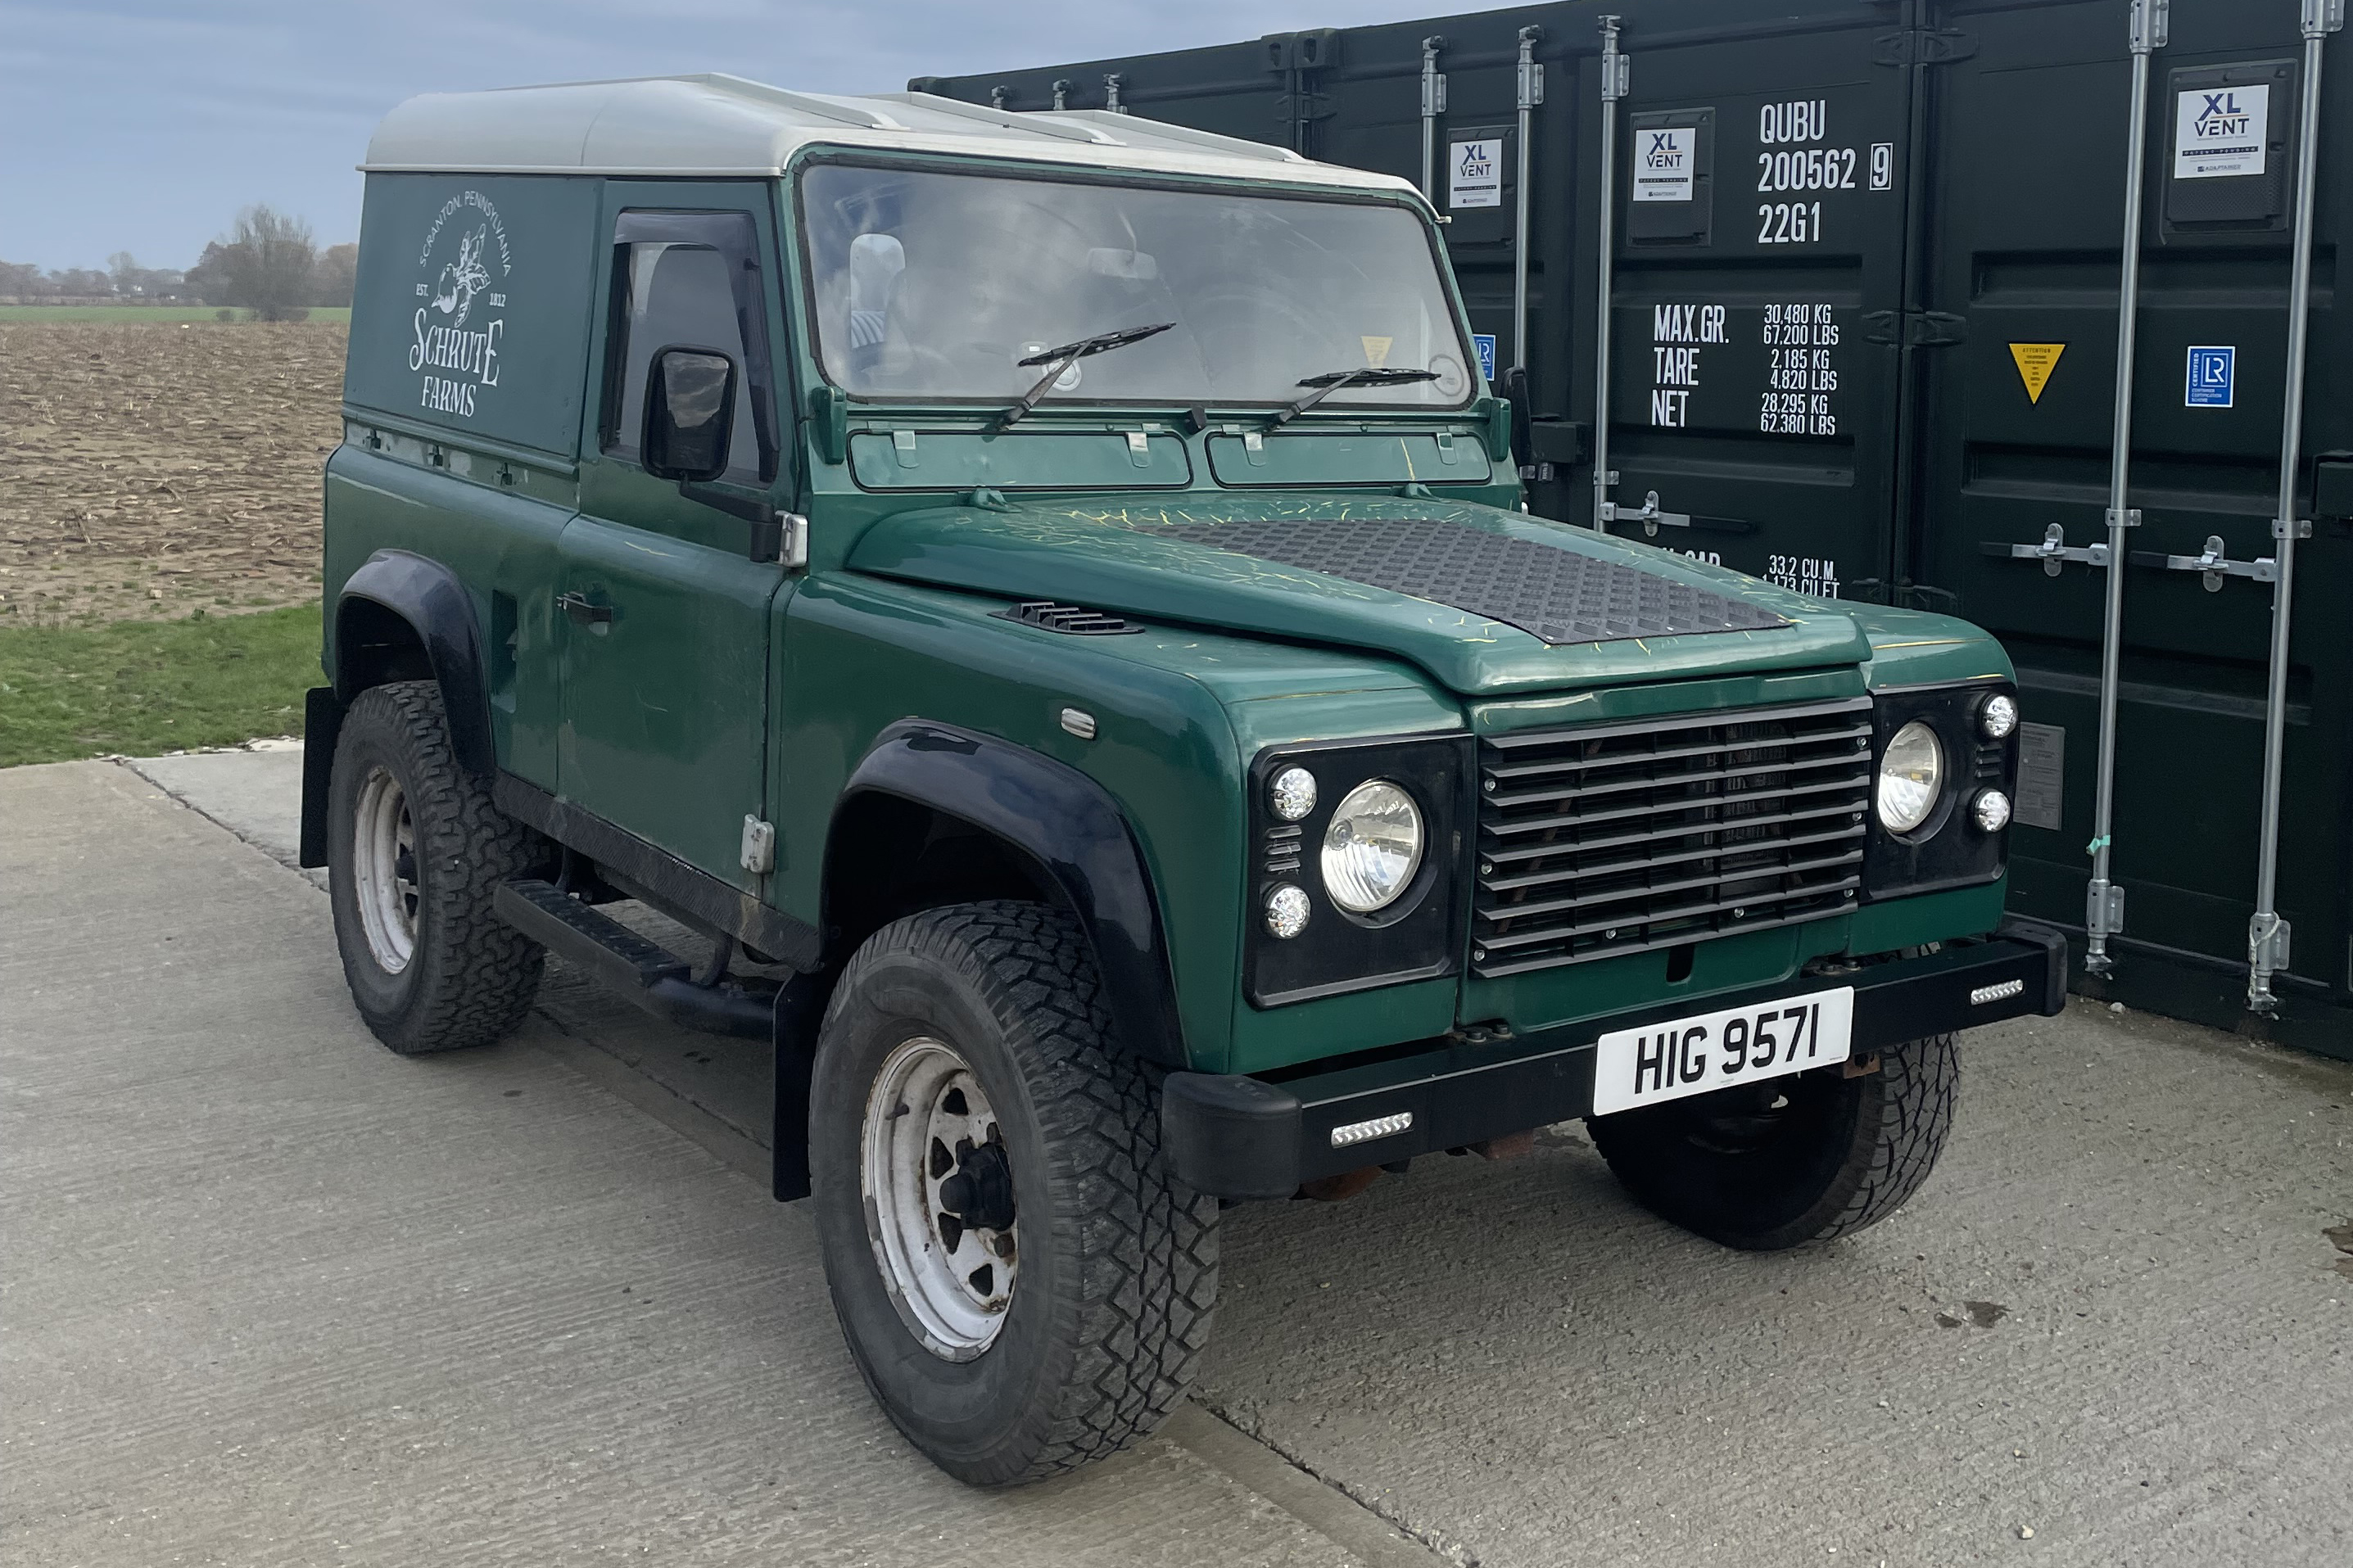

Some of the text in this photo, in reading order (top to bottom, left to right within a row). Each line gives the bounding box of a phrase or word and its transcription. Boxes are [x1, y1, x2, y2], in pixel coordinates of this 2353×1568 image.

[2197, 92, 2242, 121] XL
[1760, 99, 1826, 144] QUBU
[2194, 118, 2250, 137] VENT
[1462, 144, 1486, 166] XL
[1649, 133, 1677, 156] XL
[1460, 163, 1491, 178] VENT
[1646, 154, 1683, 168] VENT
[1758, 146, 1890, 192] 200562 9
[464, 190, 512, 278] PENNSYLVANIA
[1758, 201, 1821, 244] 22G1
[415, 282, 429, 297] EST.
[1654, 304, 1730, 344] MAX.GR.
[1763, 303, 1832, 325] 30,480 KG
[1762, 324, 1839, 346] 67,200 LBS
[409, 307, 504, 387] SCHRUTE
[1654, 346, 1700, 386] TARE
[1771, 348, 1830, 370] 2,185 KG
[1811, 369, 1838, 391] LBS
[421, 375, 477, 418] FARMS
[1651, 388, 1690, 427] NET
[1810, 394, 1828, 415] KG
[1809, 414, 1836, 436] LBS
[1768, 554, 1838, 581] 33.2 CU.M.
